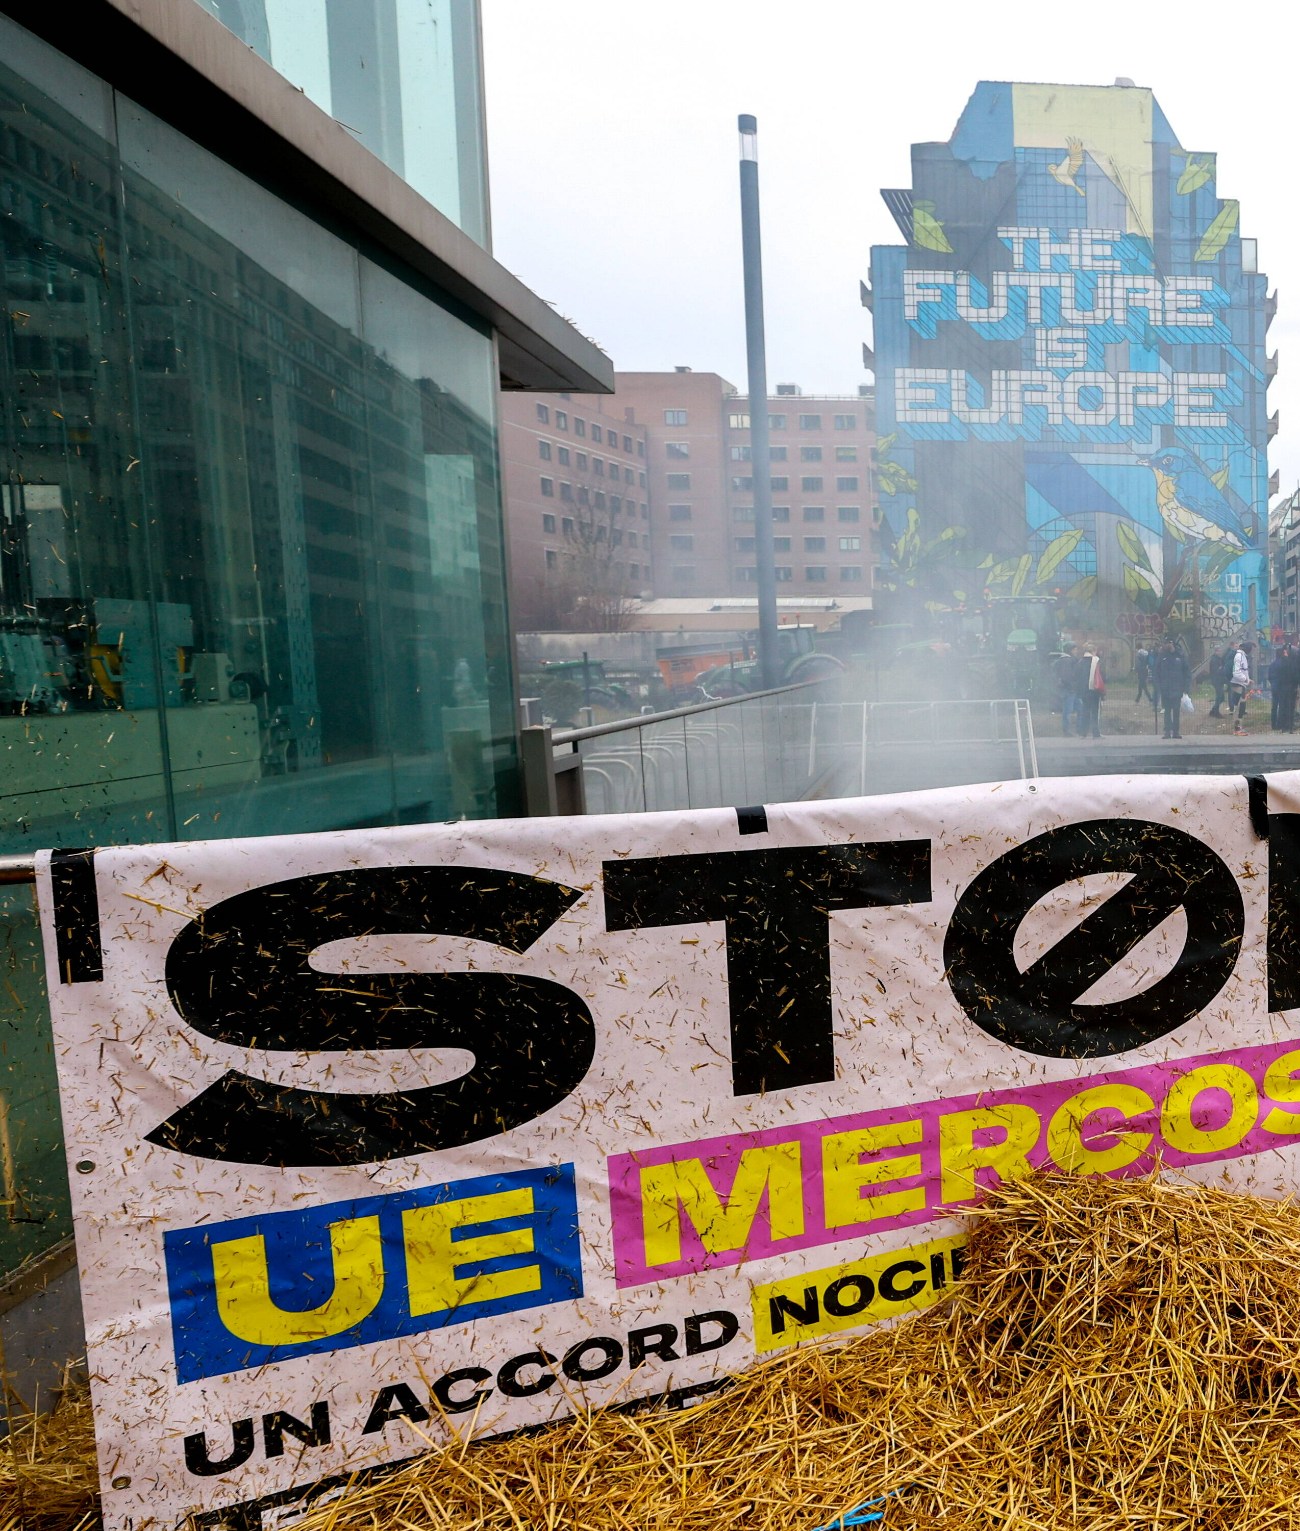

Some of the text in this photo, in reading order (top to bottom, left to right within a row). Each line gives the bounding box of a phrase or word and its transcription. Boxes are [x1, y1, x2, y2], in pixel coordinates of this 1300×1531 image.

[997, 227, 1121, 270] THE
[903, 270, 1215, 328] FUTURE
[1034, 327, 1089, 369] IS
[895, 368, 1229, 428] EUROPE
[210, 1186, 542, 1346] UE
[182, 1401, 332, 1478] UN
[362, 1309, 741, 1436] ACCORD
